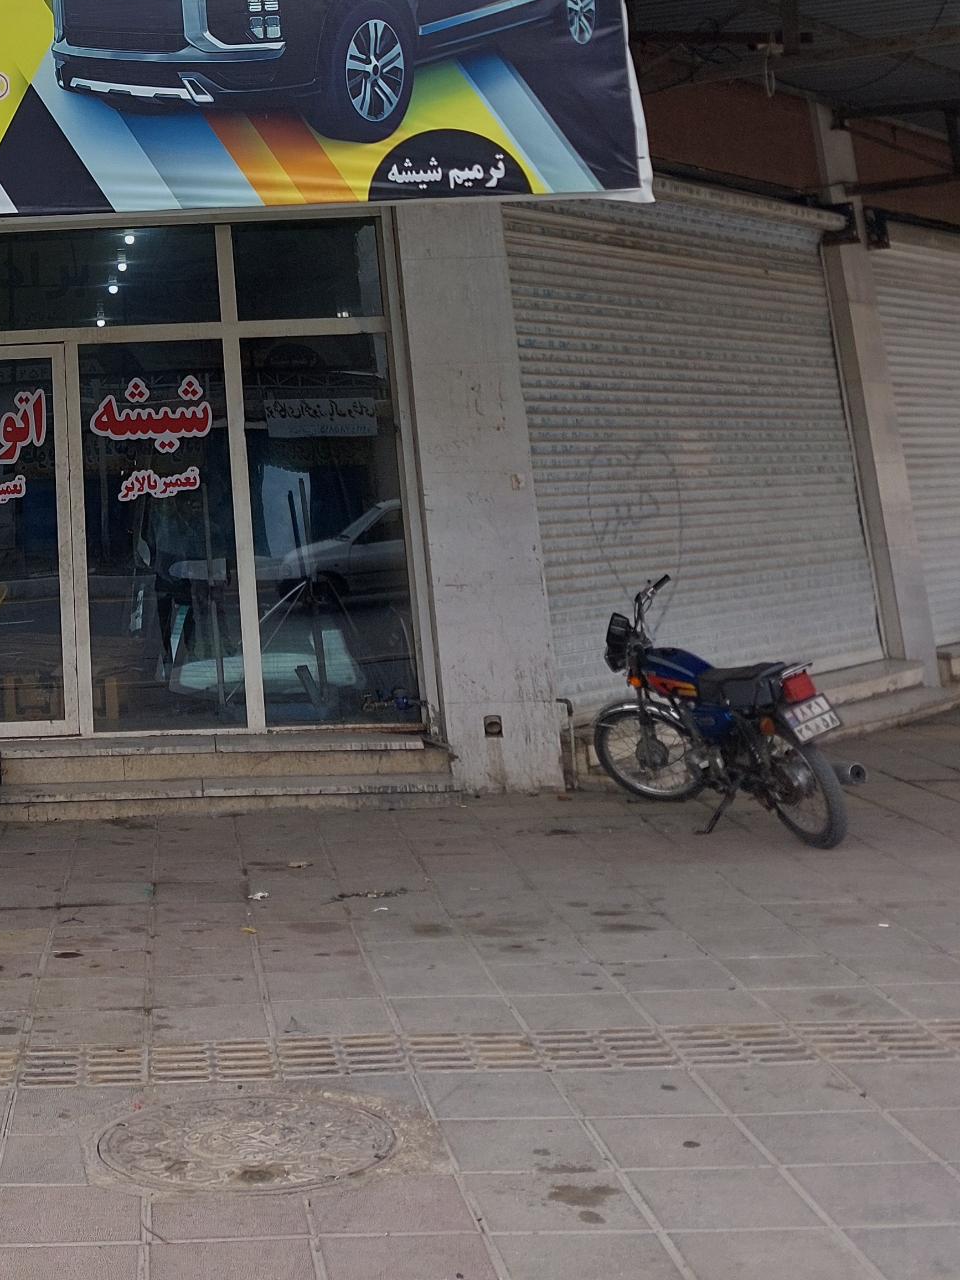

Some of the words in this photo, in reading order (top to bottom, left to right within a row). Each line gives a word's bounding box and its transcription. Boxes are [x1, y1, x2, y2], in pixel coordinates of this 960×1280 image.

[387, 156, 443, 189] شیشه
[447, 152, 506, 189] ترمیم
[91, 376, 212, 452] شیشه
[119, 472, 159, 500] بالابر
[158, 467, 200, 497] تعمیر
